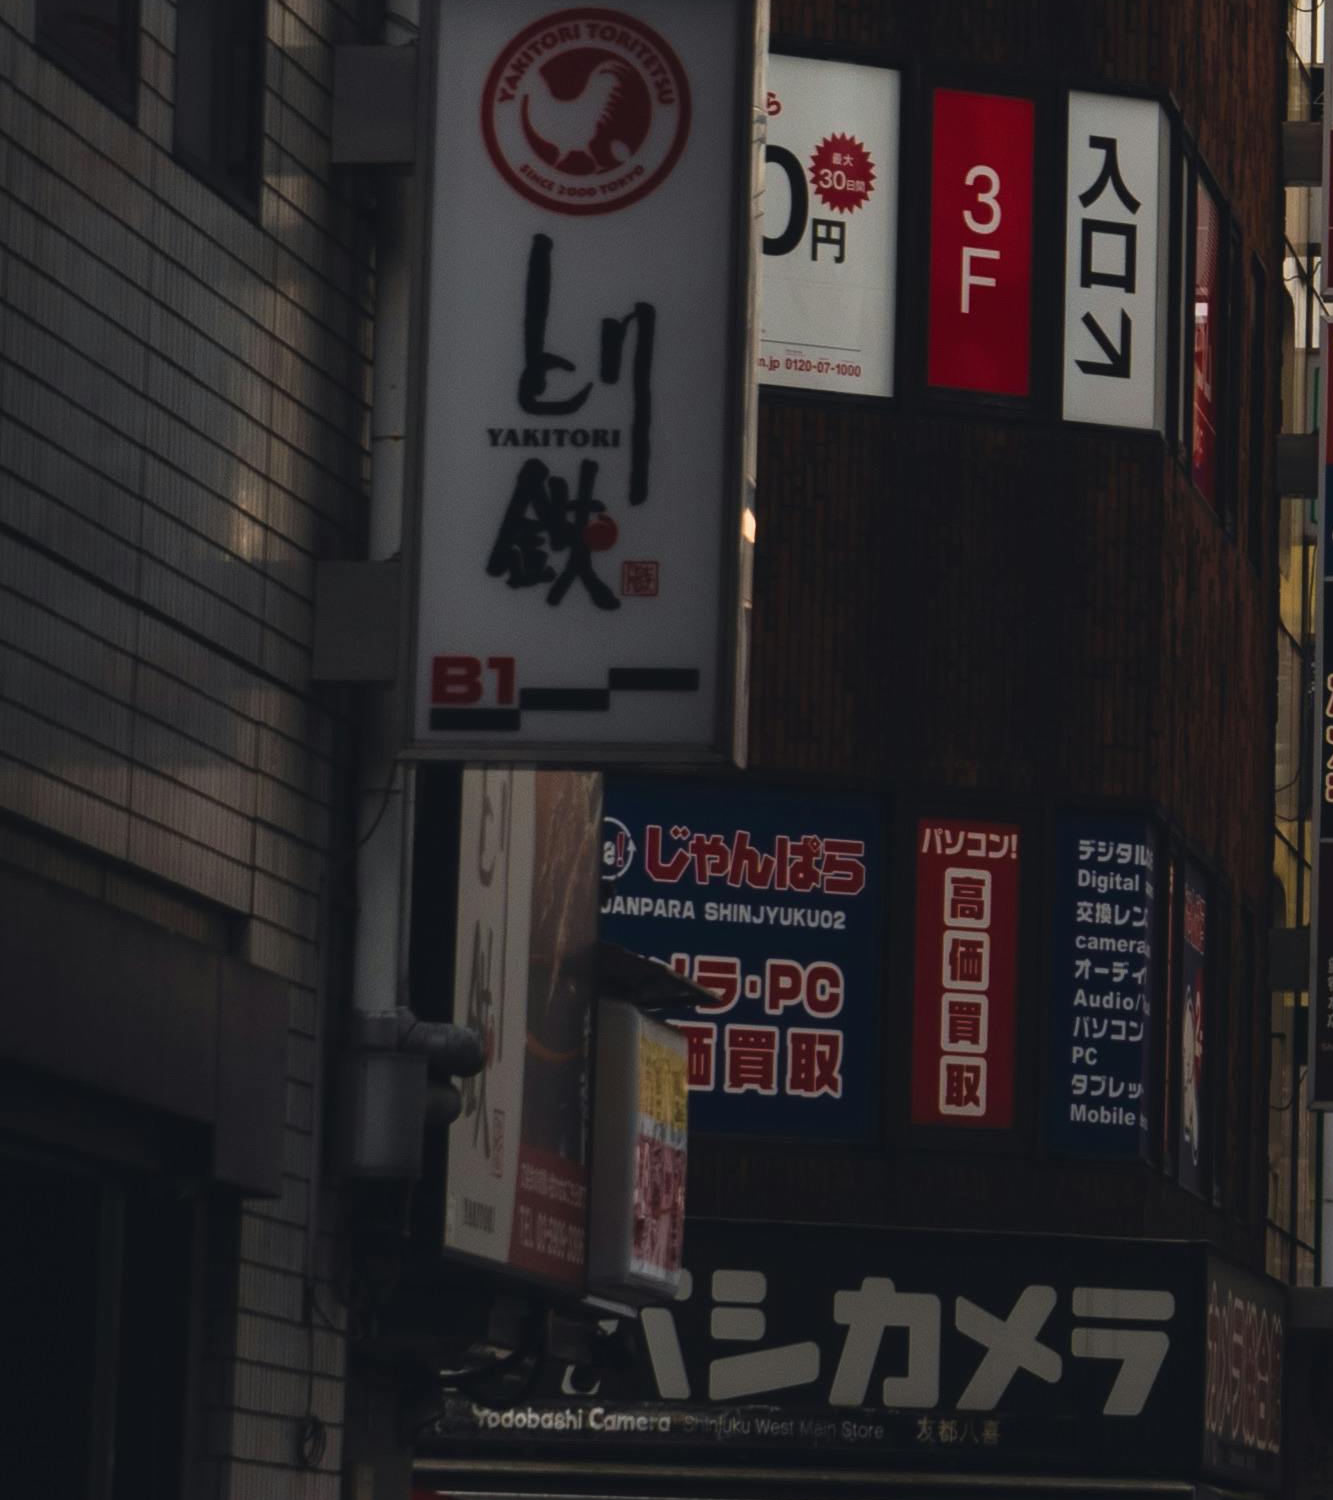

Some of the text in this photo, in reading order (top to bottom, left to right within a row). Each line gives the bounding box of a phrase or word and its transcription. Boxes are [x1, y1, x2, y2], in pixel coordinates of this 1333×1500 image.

[498, 23, 675, 105] YAKITORI TORITETSU
[557, 185, 597, 198] 2000
[1079, 136, 1143, 296] 入口
[957, 164, 1005, 315] 3F
[487, 233, 656, 611] とり鉄
[487, 427, 621, 449] YAKITORI
[430, 656, 516, 707] B1
[645, 824, 866, 896] じゃんぱら
[921, 826, 1019, 861] パソコン!
[1077, 868, 1140, 893] Digital
[600, 895, 847, 930] JANPARA SHINJYUKU02
[1076, 900, 1149, 928] 交換レン
[941, 874, 987, 1110] 高価買取
[1072, 1017, 1145, 1042] パソコン
[1071, 1046, 1099, 1066] PC
[1070, 1073, 1145, 1099] タブレッ
[1069, 1102, 1137, 1128] Mobile
[471, 1404, 583, 1430] Yodobashi
[588, 1406, 672, 1433] Camera
[754, 1420, 795, 1436] West
[841, 1421, 885, 1442] Store
[915, 1417, 1001, 1447] 友都八喜
